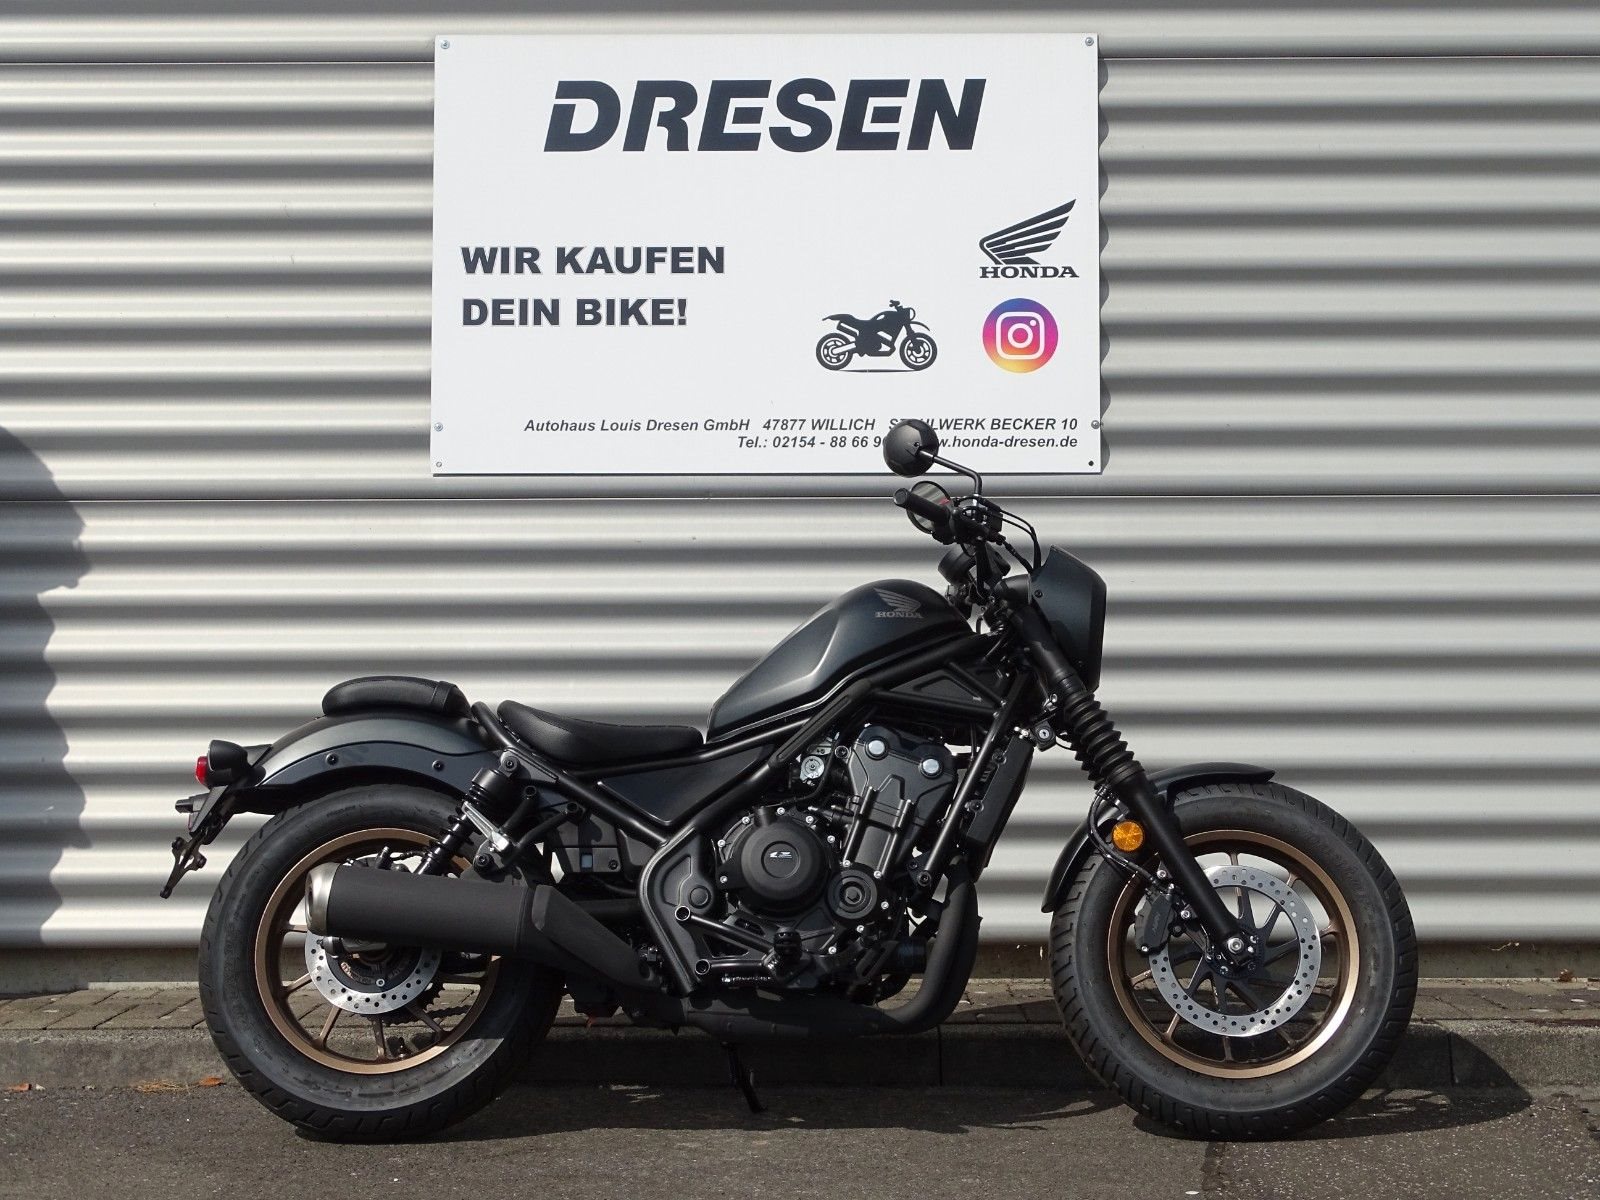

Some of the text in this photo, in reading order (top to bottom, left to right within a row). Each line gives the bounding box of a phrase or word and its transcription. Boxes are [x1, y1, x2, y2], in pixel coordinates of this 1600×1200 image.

[544, 78, 986, 152] DRESEN
[461, 246, 725, 274] WIR KAUFEN
[980, 265, 1079, 279] HONDA
[463, 298, 687, 326] DEIN BIKE!
[524, 418, 1078, 432] Autohaus Louis Dresen GmbH 47877 WILLICH SLWERK BECKER 10
[737, 436, 768, 448] Tel.:
[772, 435, 816, 448] 02154
[829, 435, 847, 448] 88
[851, 435, 869, 448] 66
[873, 435, 885, 448] 9
[874, 611, 924, 619] HONDA
